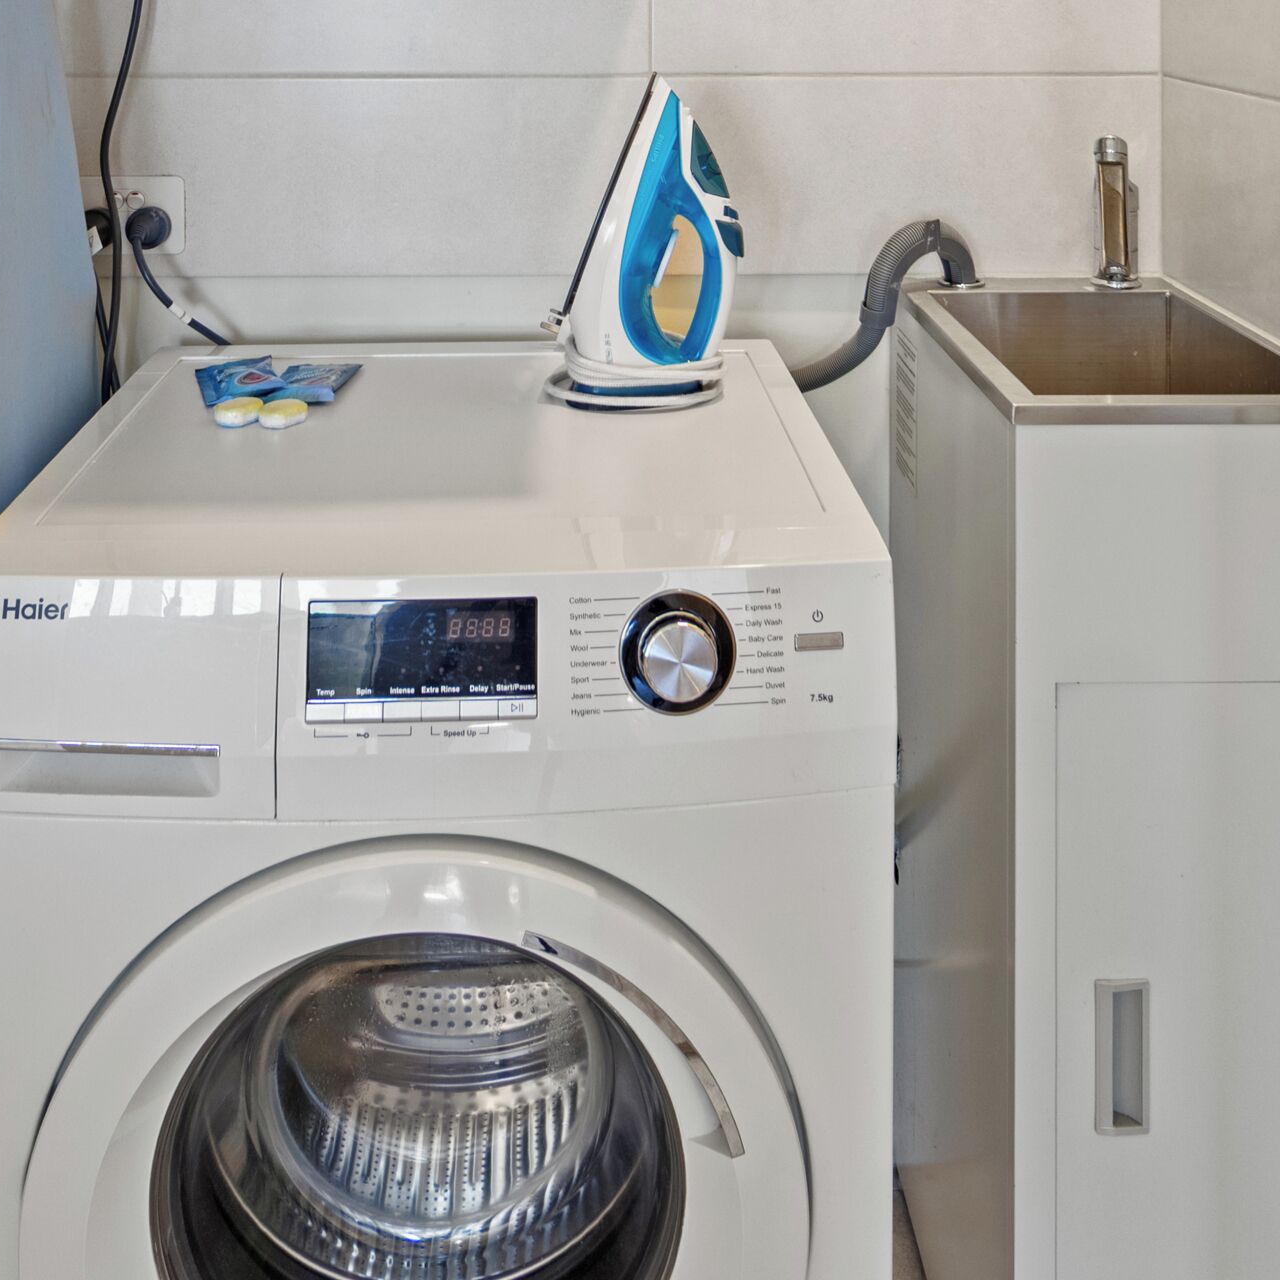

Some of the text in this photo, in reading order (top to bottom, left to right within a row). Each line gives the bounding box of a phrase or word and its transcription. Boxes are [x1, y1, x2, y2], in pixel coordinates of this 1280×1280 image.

[766, 587, 781, 595] Fast
[569, 596, 591, 604] Cotton
[2, 598, 68, 620] Haier
[745, 603, 771, 611] Express
[570, 612, 601, 620] Synthetic
[746, 618, 782, 628] Daily Wash
[570, 628, 581, 636] Mix
[749, 634, 783, 643] Baby Care
[757, 650, 784, 658] Delicate
[570, 659, 607, 667] Underwear
[746, 666, 763, 674] Hand
[571, 676, 589, 685] Sport
[441, 685, 460, 693] Rinse
[470, 685, 489, 693] Delay
[496, 683, 535, 691] Start/Pause
[766, 681, 785, 689] Duvet
[356, 688, 371, 696] Spin
[571, 692, 591, 700] Jeans
[771, 697, 786, 706] Spin
[810, 693, 833, 702] 7.5kg
[571, 707, 600, 716] Hygienic
[467, 729, 476, 737] Up
